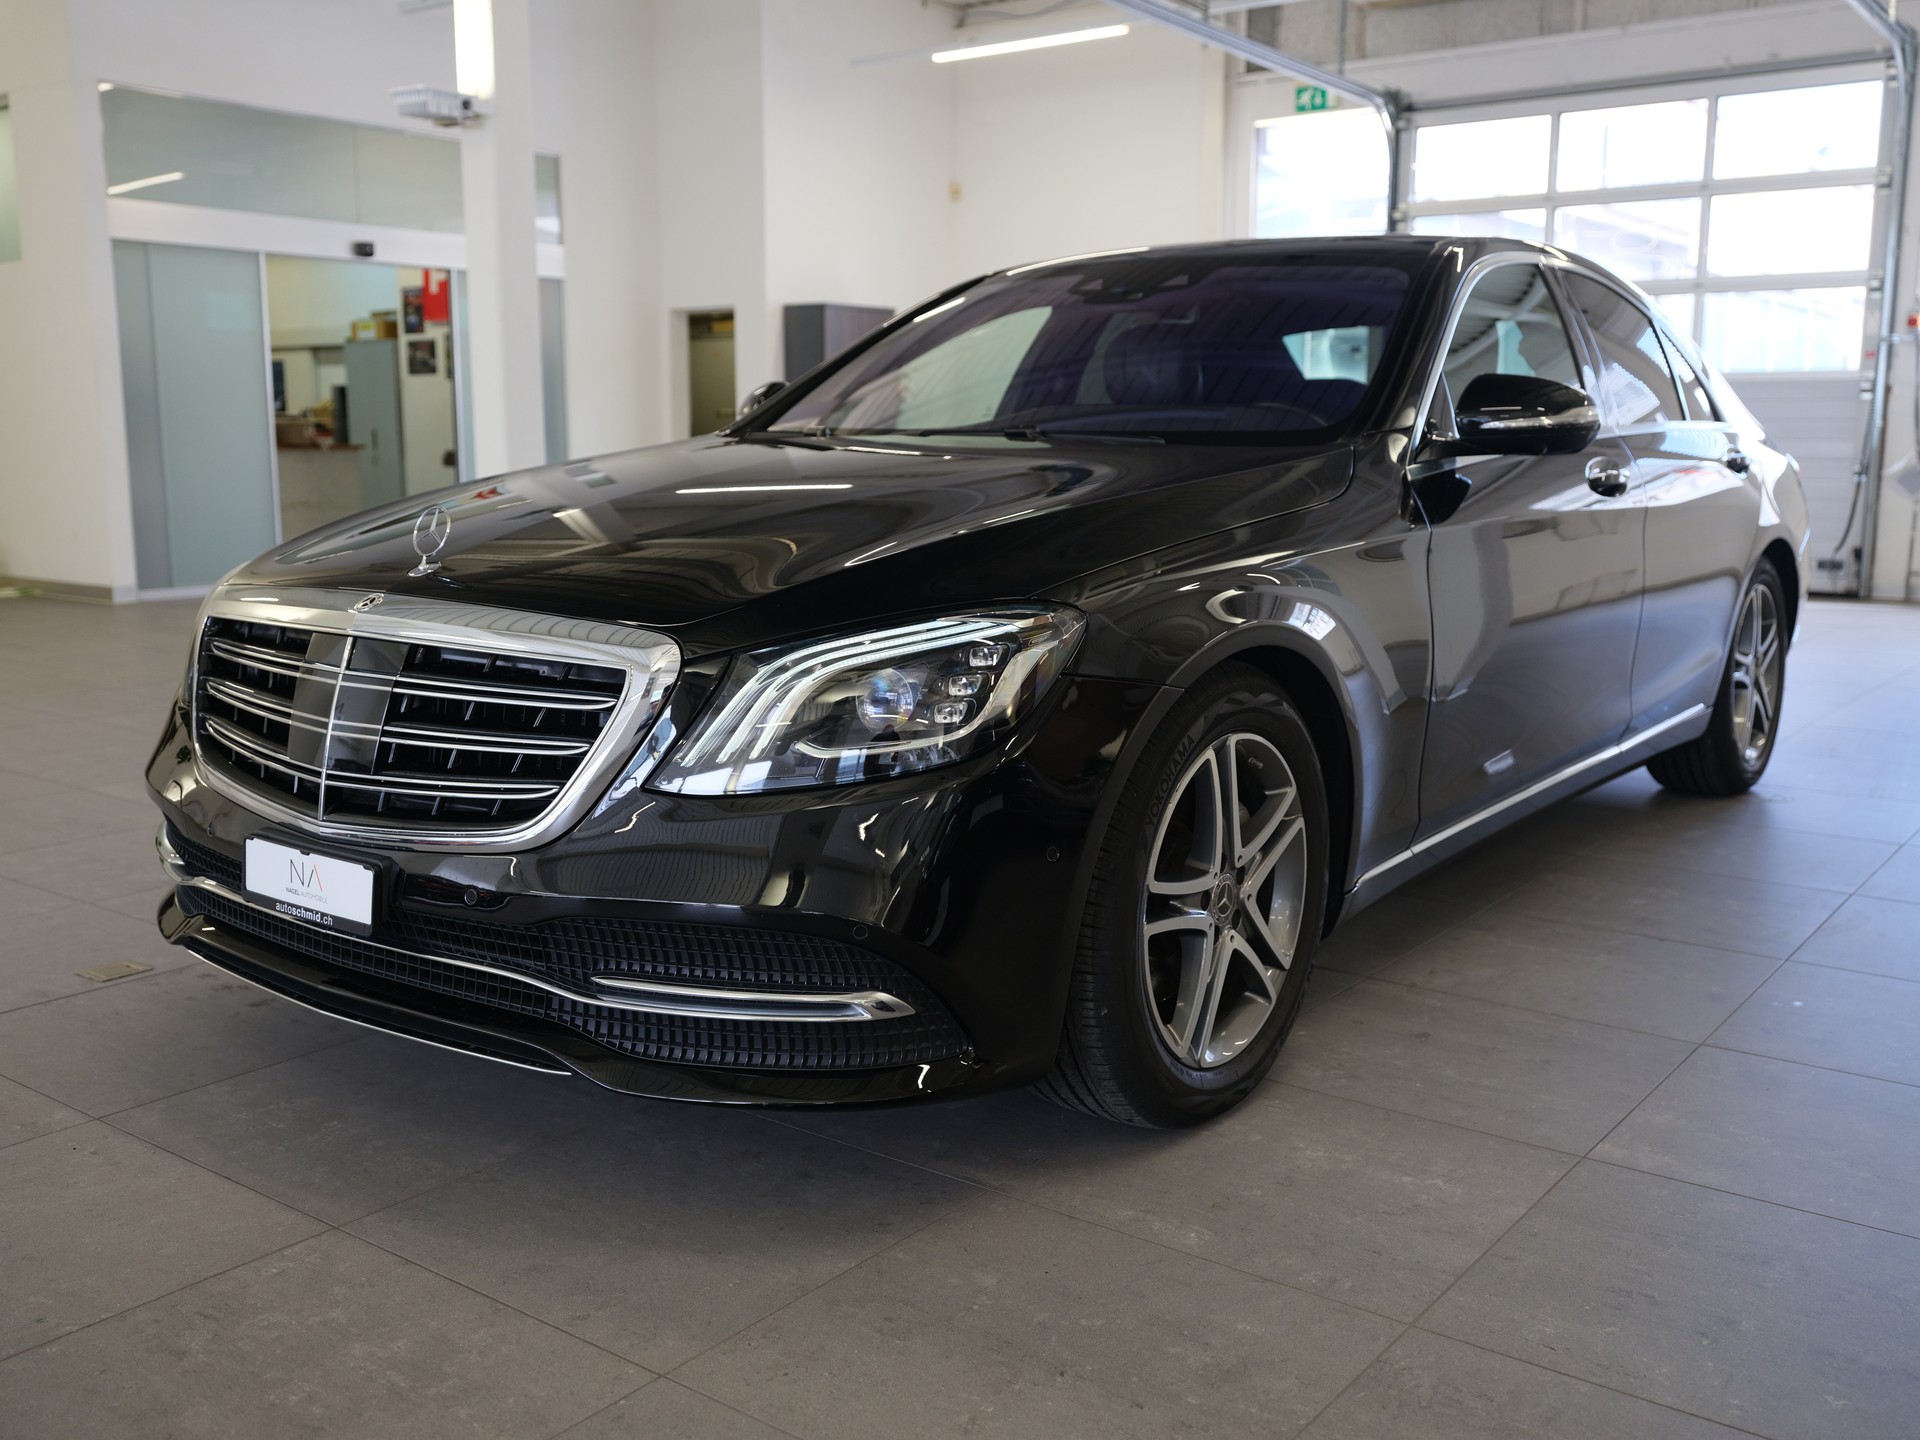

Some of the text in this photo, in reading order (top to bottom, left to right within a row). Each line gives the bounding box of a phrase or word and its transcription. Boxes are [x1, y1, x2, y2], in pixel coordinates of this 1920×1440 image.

[1146, 734, 1195, 826] YOKOHAMA
[285, 886, 328, 904] NAGEL AUTOMOBILE
[275, 902, 333, 925] autoschmid.ch
